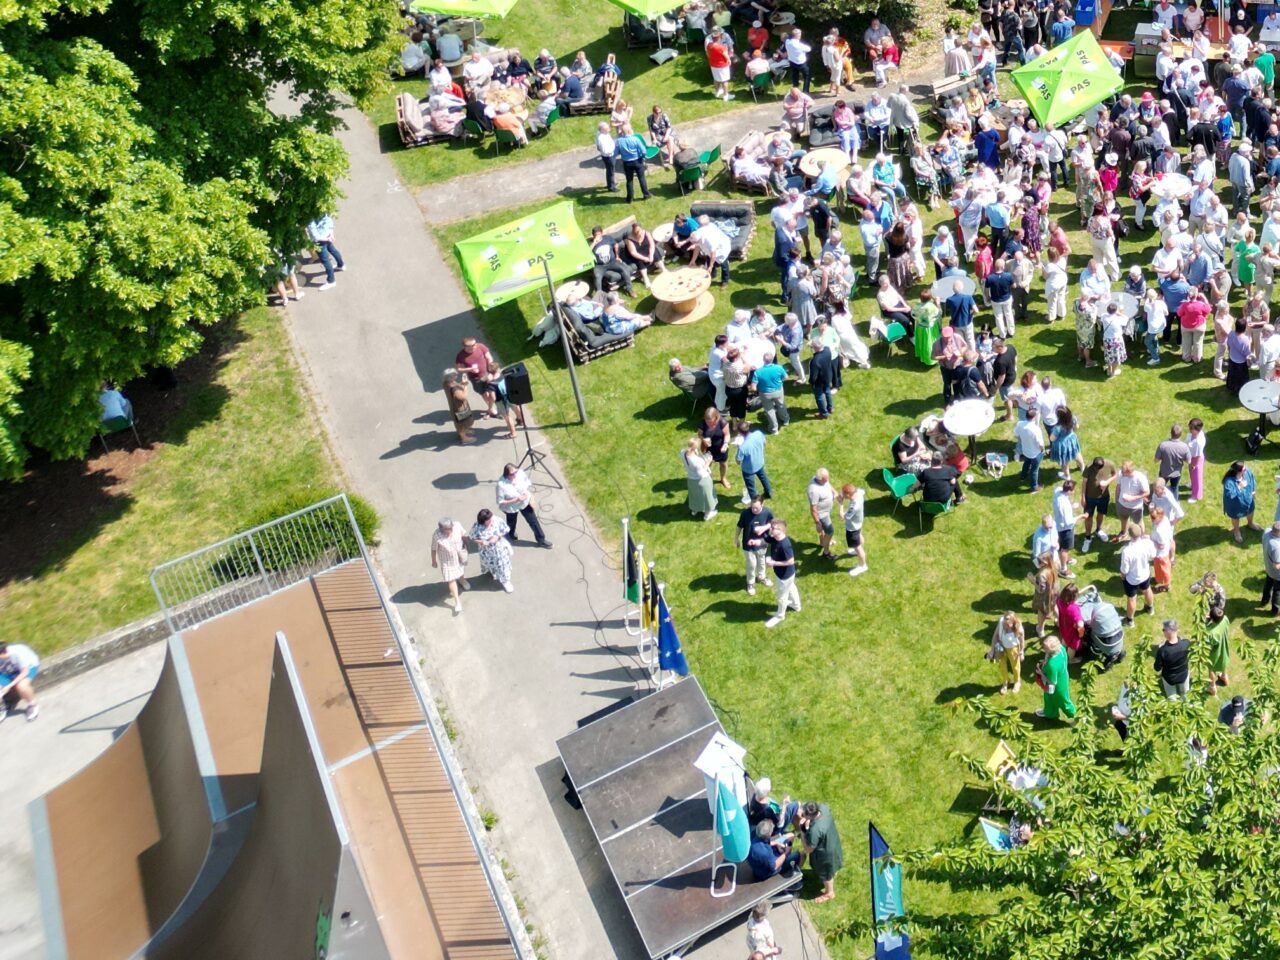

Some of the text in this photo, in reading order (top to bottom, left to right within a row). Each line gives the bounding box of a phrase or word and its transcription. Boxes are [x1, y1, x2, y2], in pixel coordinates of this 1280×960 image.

[1076, 49, 1090, 65] PAS
[1038, 83, 1052, 101] PAS
[1070, 78, 1092, 95] PAS
[487, 254, 502, 272] PAS
[527, 251, 555, 267] PAS
